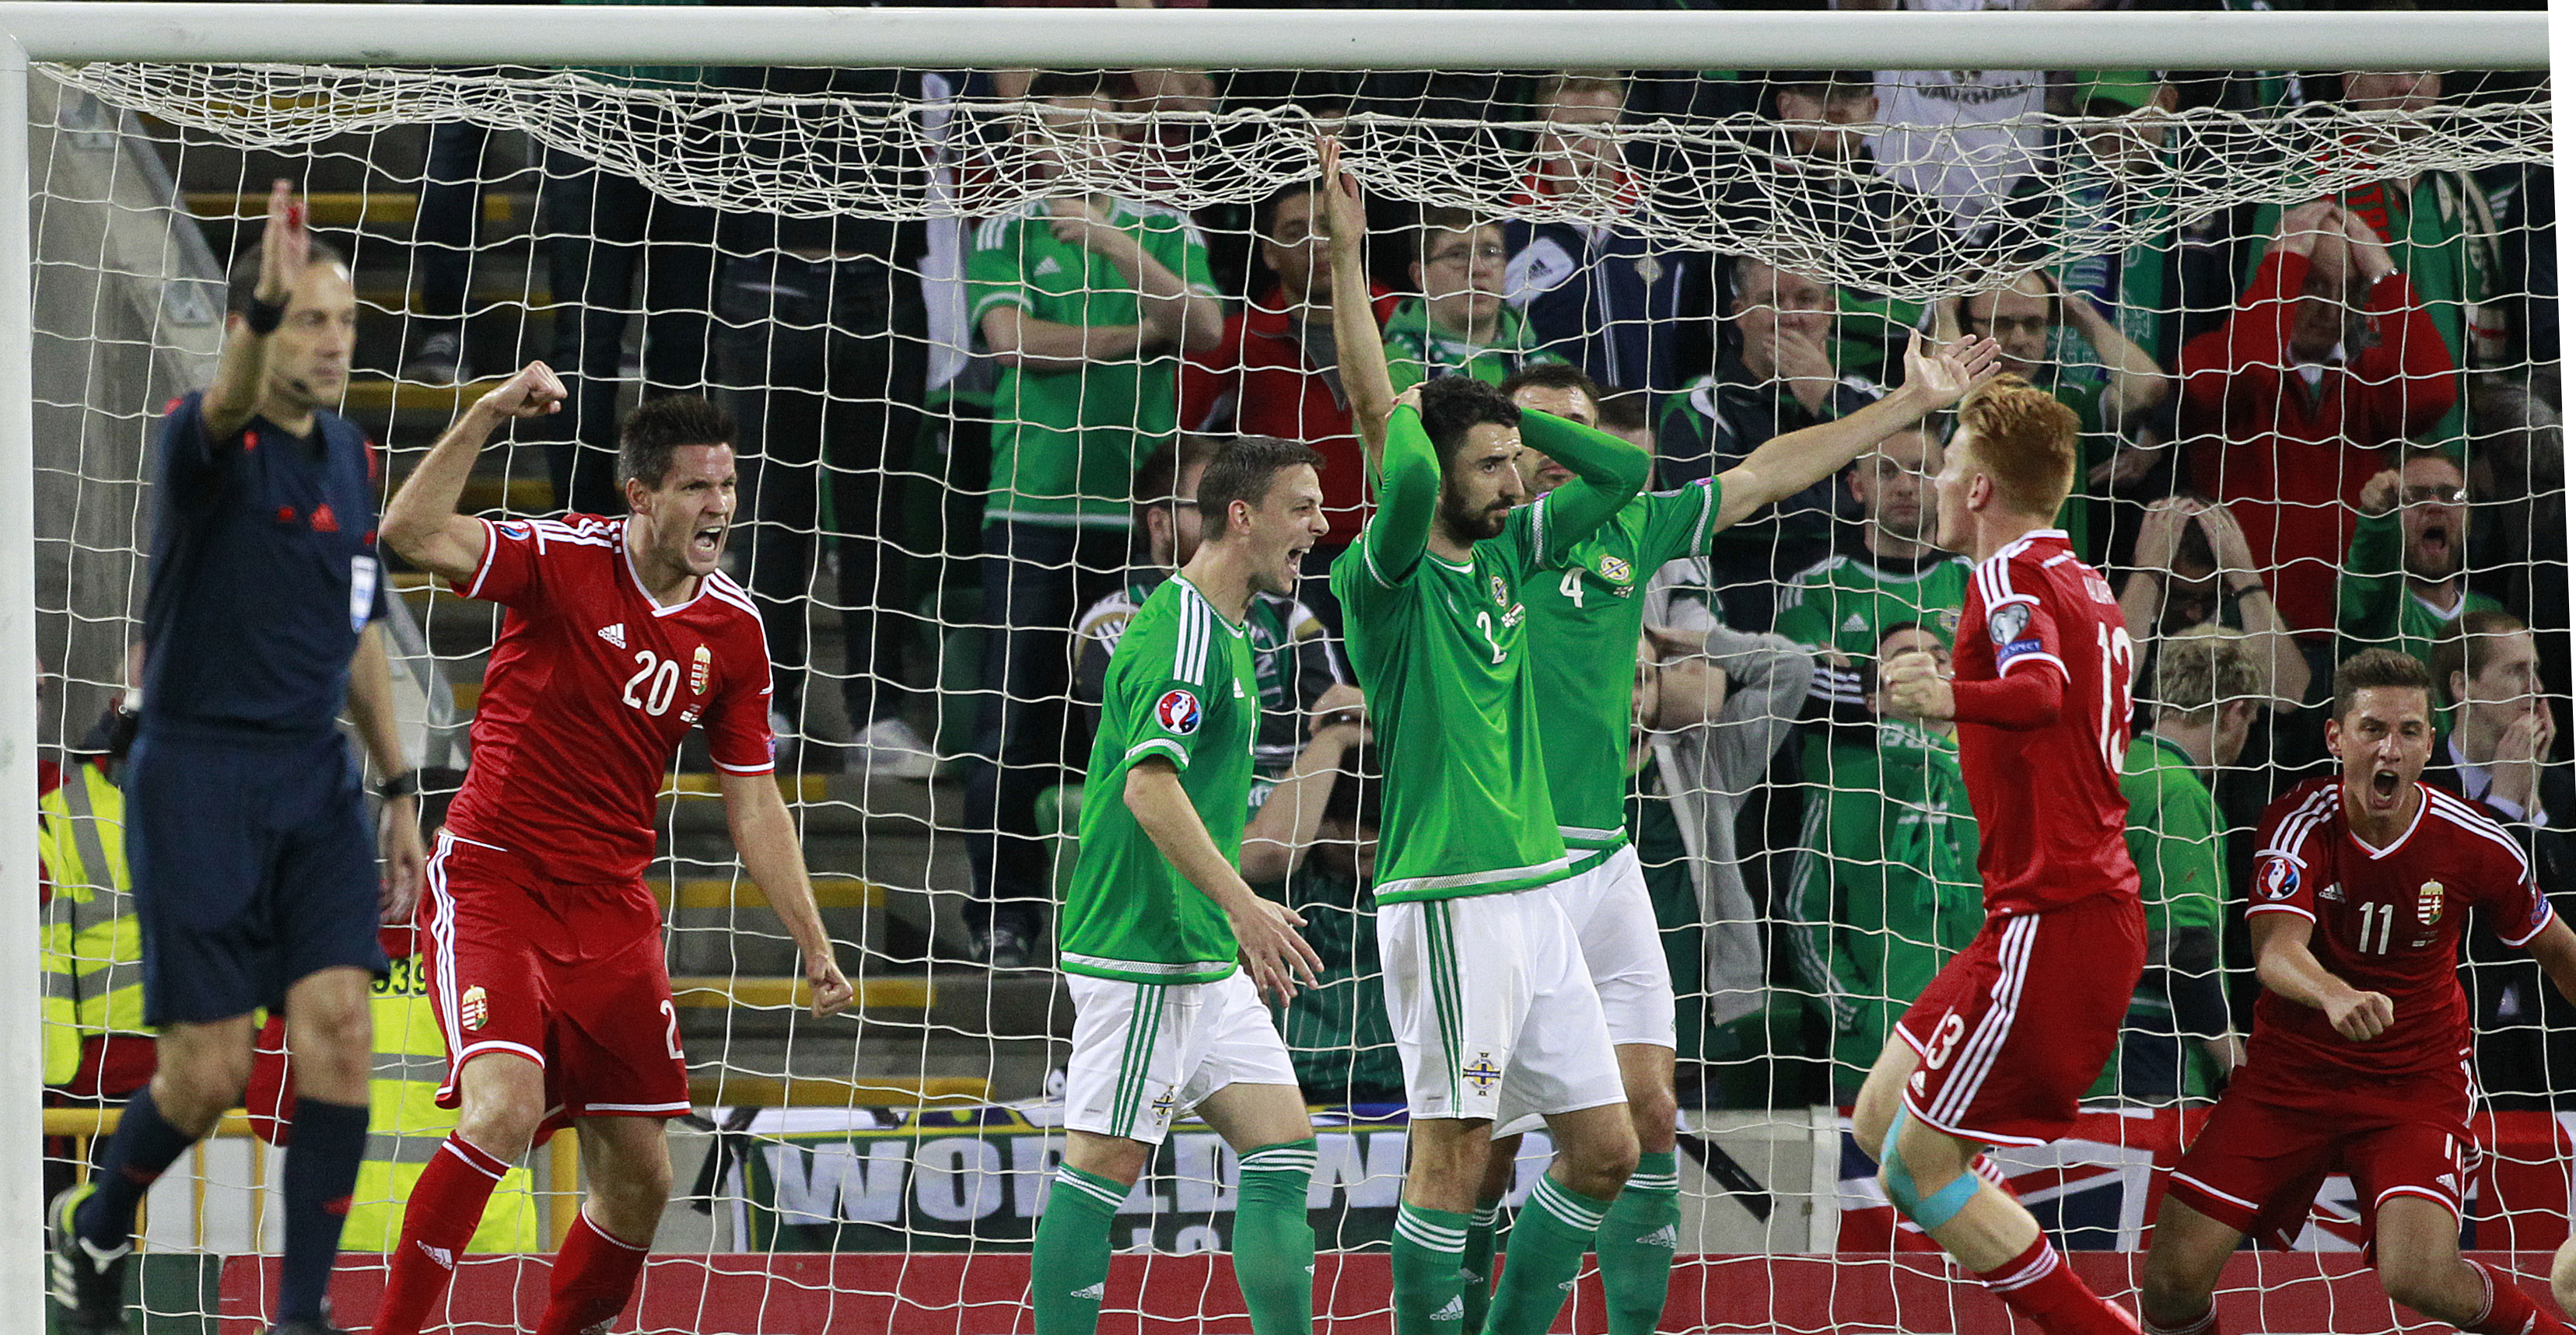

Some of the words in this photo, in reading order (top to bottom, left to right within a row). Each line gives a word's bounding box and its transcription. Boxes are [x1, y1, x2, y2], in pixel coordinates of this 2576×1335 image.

[1559, 567, 1588, 609] 4
[597, 628, 627, 650] adidas
[1475, 610, 1508, 665] 2
[622, 649, 680, 716] 20
[2097, 621, 2134, 775] 13
[2359, 901, 2394, 955] 11
